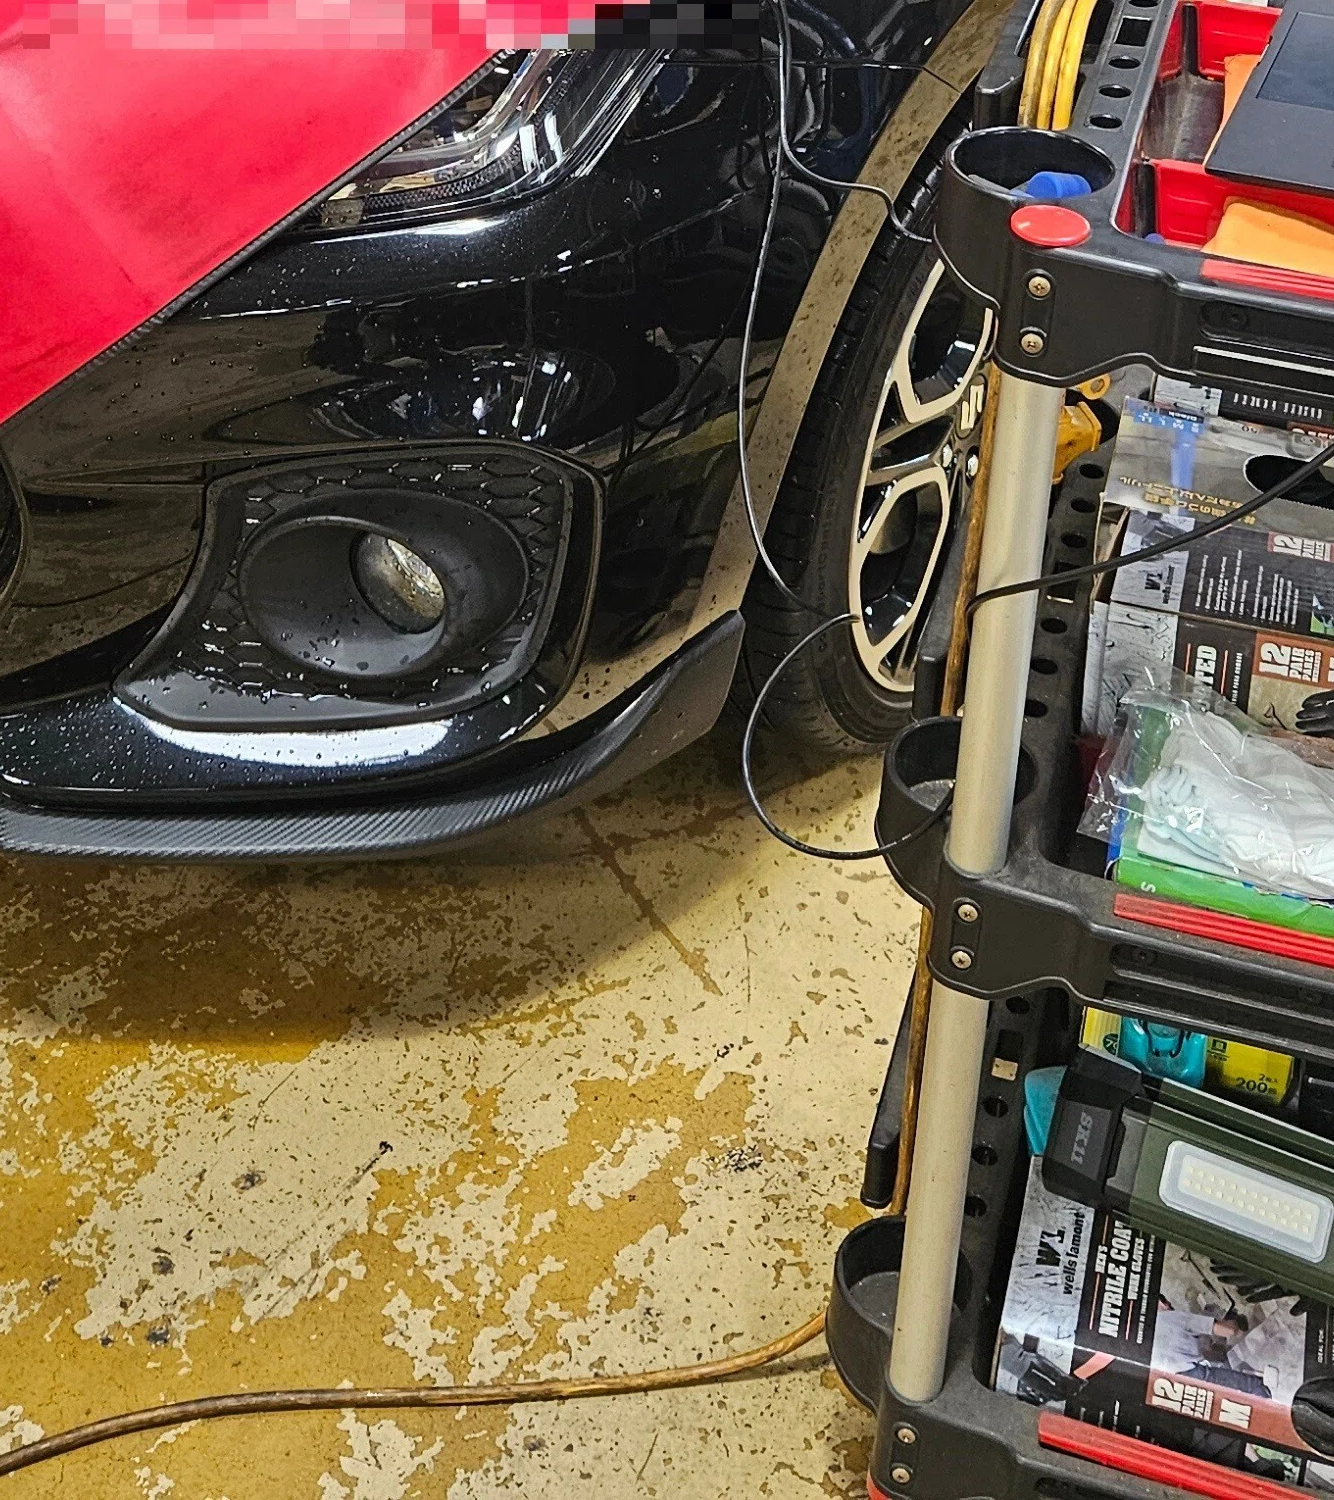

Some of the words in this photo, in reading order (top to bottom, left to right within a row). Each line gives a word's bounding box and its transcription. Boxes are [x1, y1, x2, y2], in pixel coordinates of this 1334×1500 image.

[1272, 535, 1303, 556] 12
[1259, 642, 1288, 675] 12
[1287, 646, 1305, 679] PAIR
[1064, 1210, 1087, 1258] lamont
[1131, 1237, 1145, 1273] GLOVES
[1060, 1259, 1080, 1296] wells
[1127, 1272, 1140, 1300] WORK
[1098, 1263, 1127, 1338] NITRILE
[1152, 1378, 1184, 1411] 12
[1179, 1383, 1200, 1416] PAIR
[1218, 1401, 1252, 1428] M
